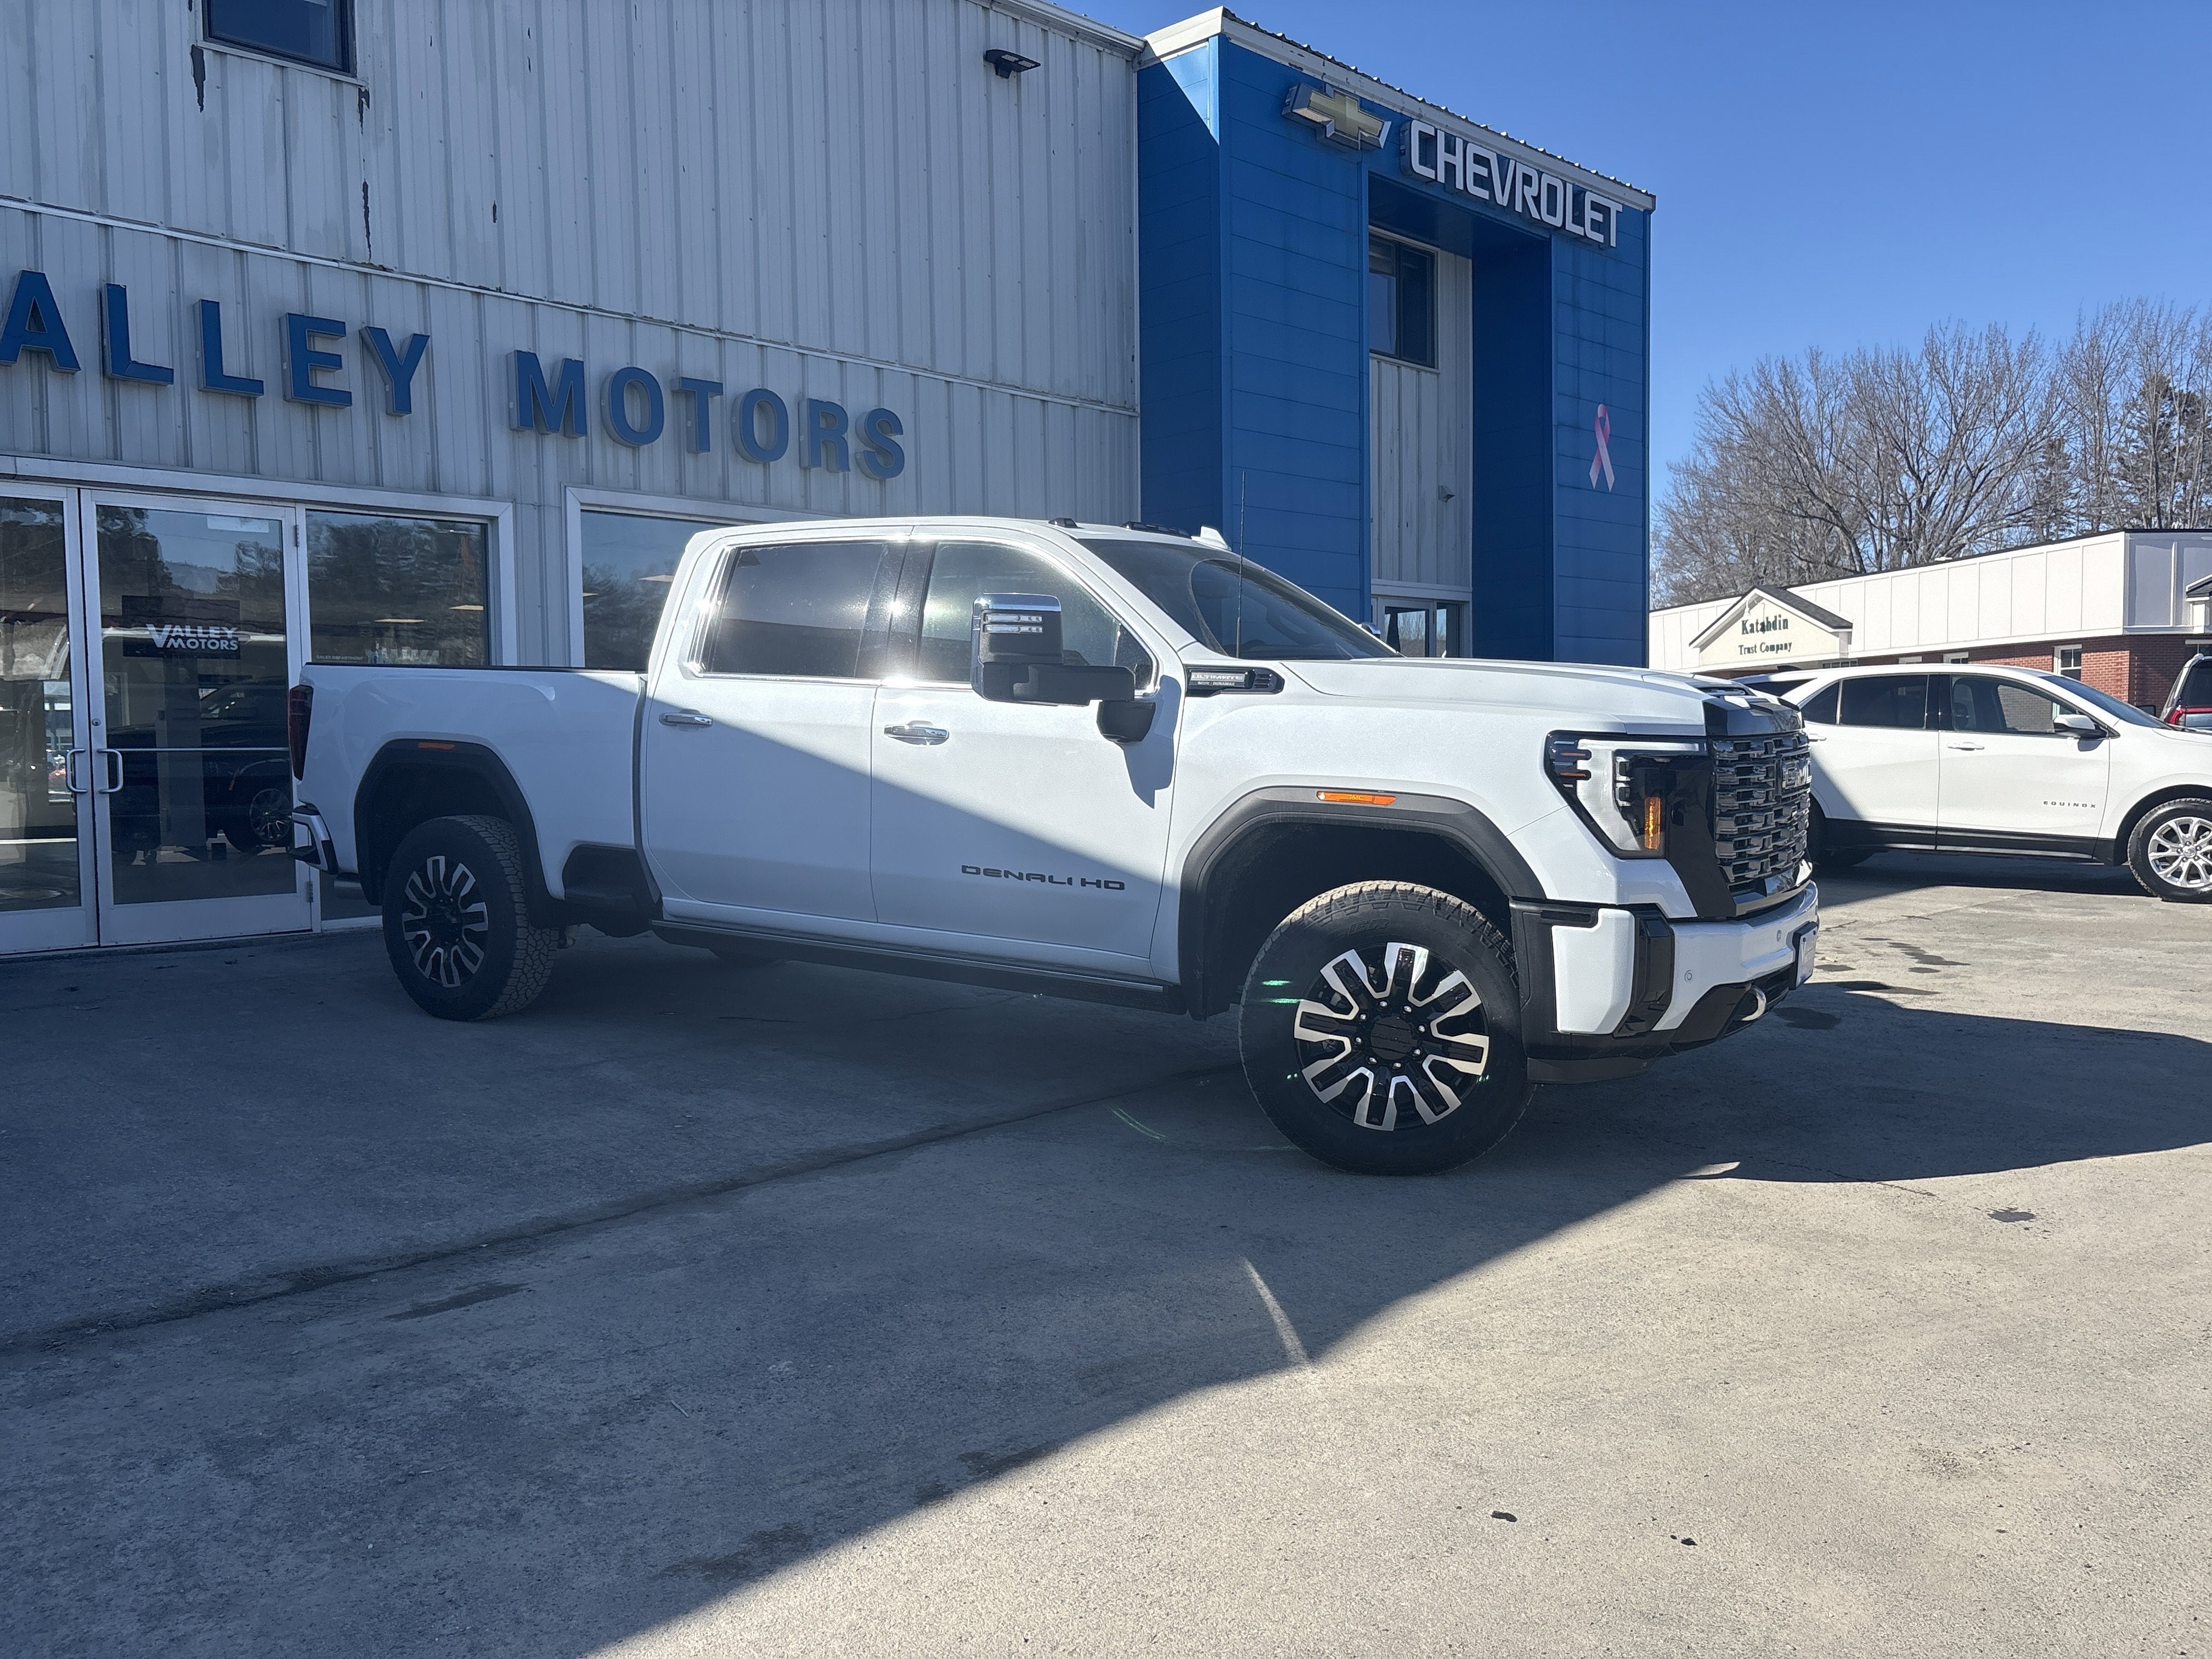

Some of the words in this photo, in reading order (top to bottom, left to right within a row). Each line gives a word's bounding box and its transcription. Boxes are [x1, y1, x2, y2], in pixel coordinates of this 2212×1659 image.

[1410, 120, 1622, 247] CHEVROLET
[0, 270, 430, 416] ALLEY
[507, 349, 905, 480] MOTORS
[145, 623, 238, 648] VALLEY
[1741, 614, 1788, 635] Katahdin
[166, 637, 238, 651] MOTORS
[1739, 644, 1757, 656] Trust
[1760, 642, 1792, 653] Company
[961, 865, 1073, 886] DENALI
[1080, 878, 1125, 890] HD
